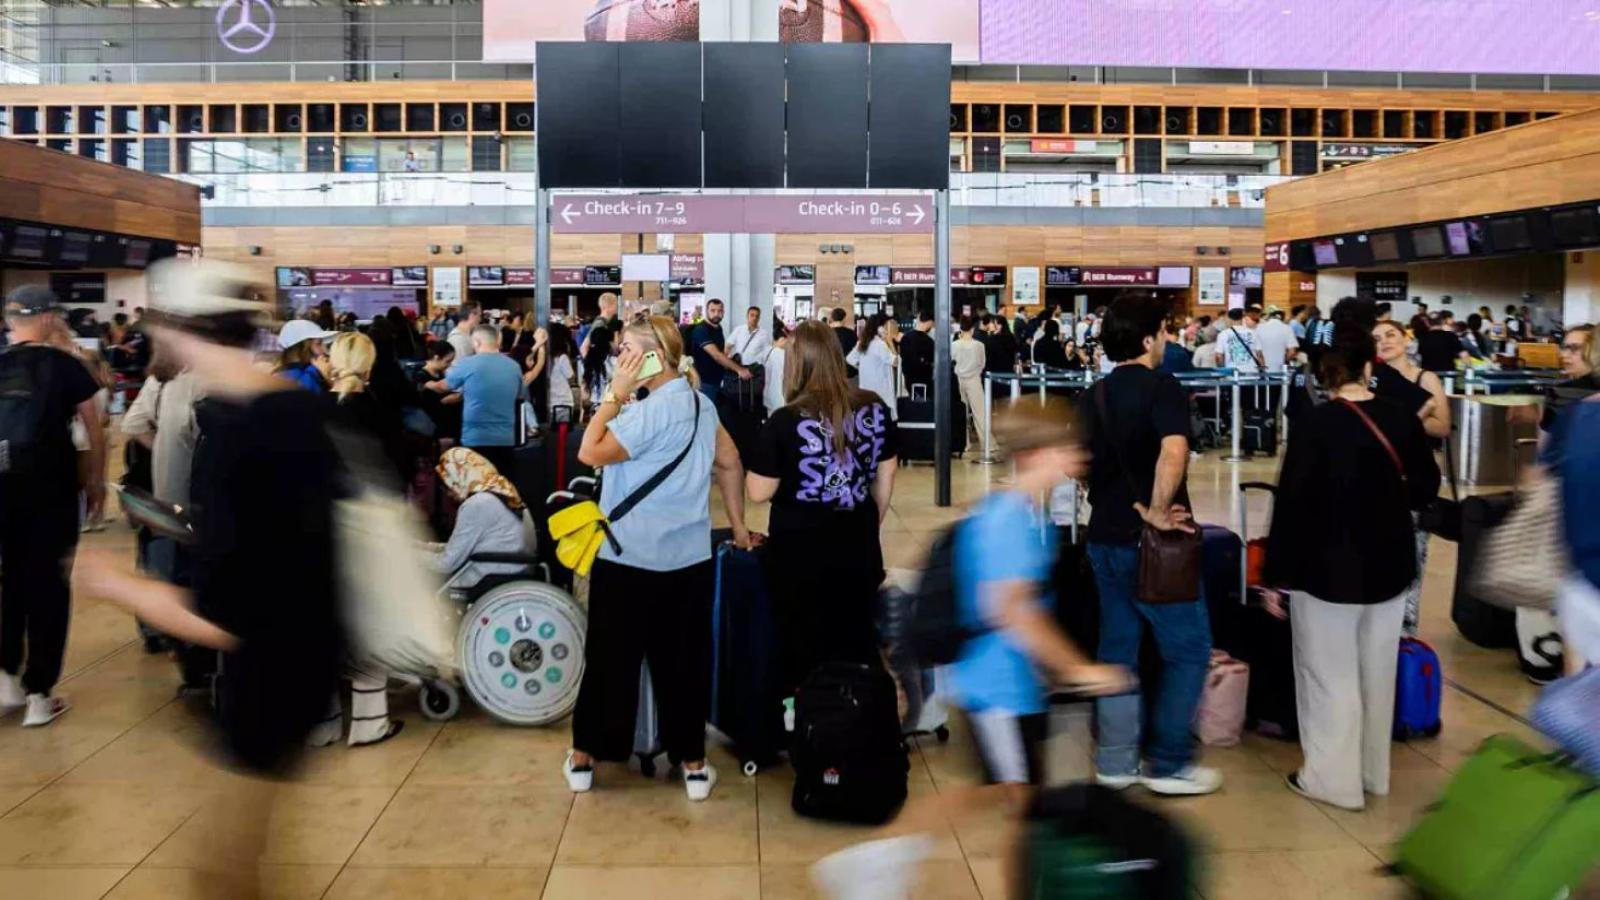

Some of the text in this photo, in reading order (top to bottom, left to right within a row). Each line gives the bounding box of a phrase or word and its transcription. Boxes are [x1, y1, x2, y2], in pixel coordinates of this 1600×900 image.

[584, 200, 652, 215] Check-in
[798, 200, 865, 215] Check-in
[1280, 244, 1289, 266] 6
